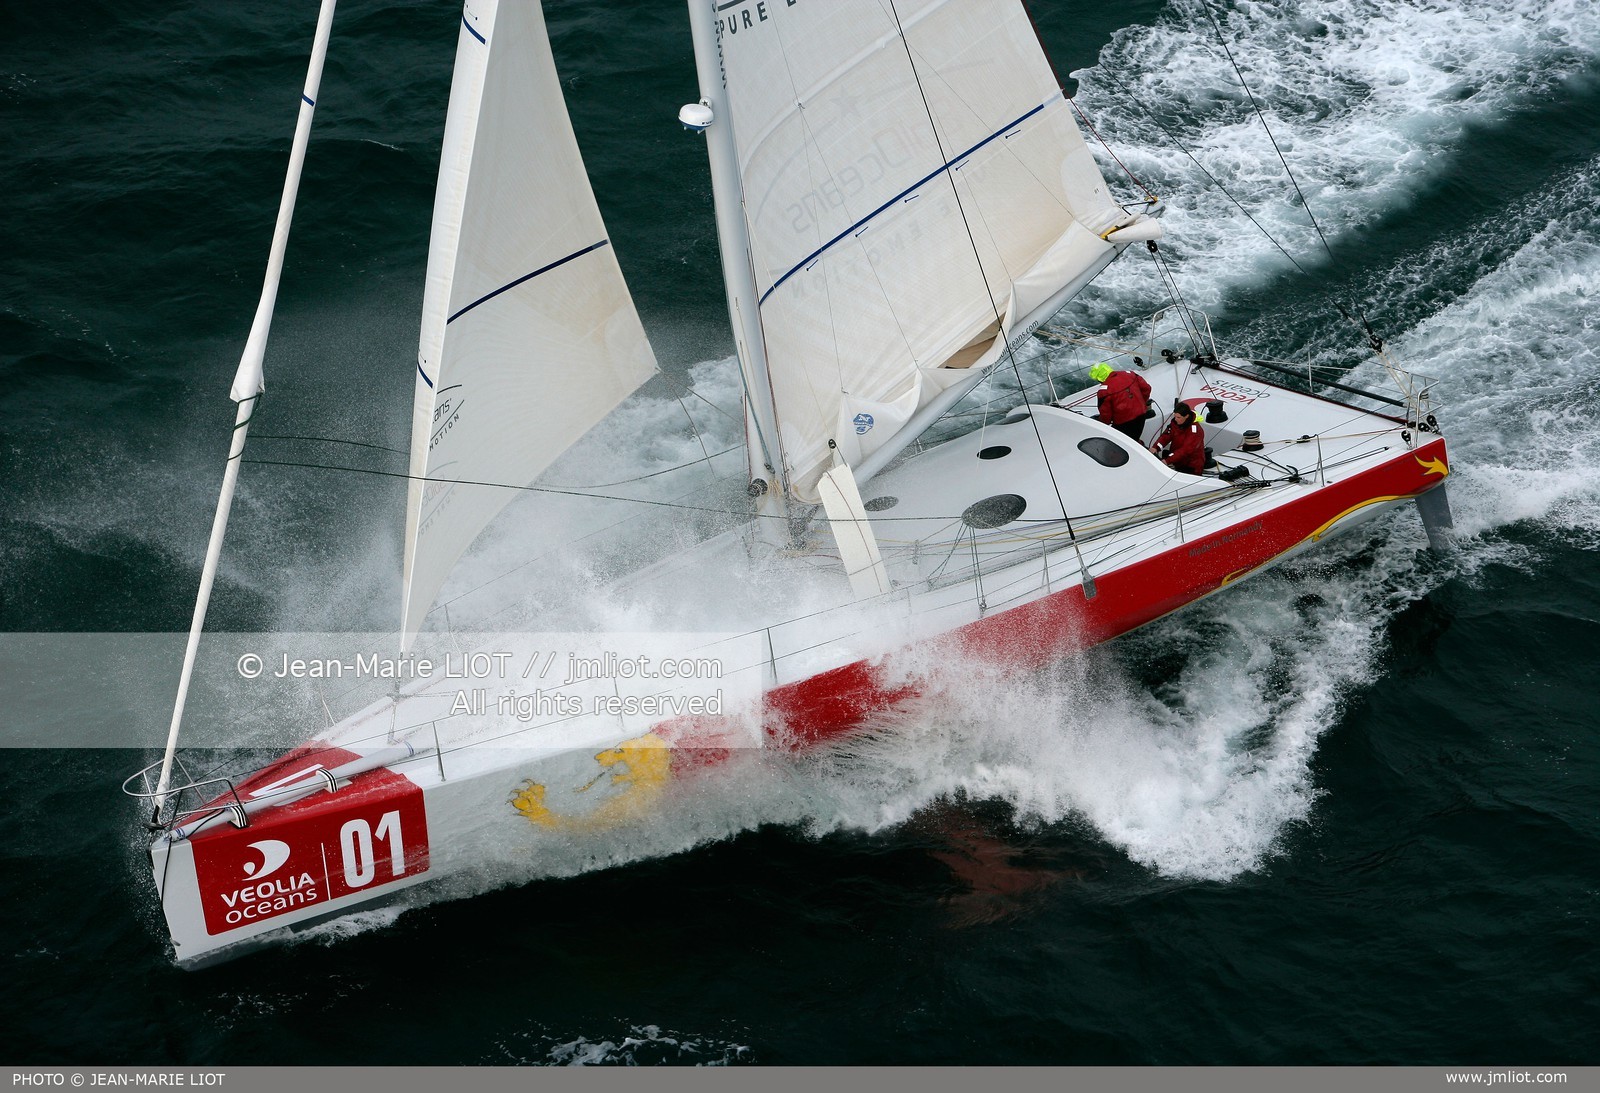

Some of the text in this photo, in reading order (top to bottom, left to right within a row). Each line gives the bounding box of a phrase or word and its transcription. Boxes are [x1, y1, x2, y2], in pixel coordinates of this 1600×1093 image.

[719, 1, 768, 39] PURE
[1200, 384, 1256, 405] VEOLIA
[1211, 379, 1271, 399] oceans
[339, 810, 406, 889] 01
[220, 872, 316, 908] VEOLIA
[225, 886, 318, 925] oceans
